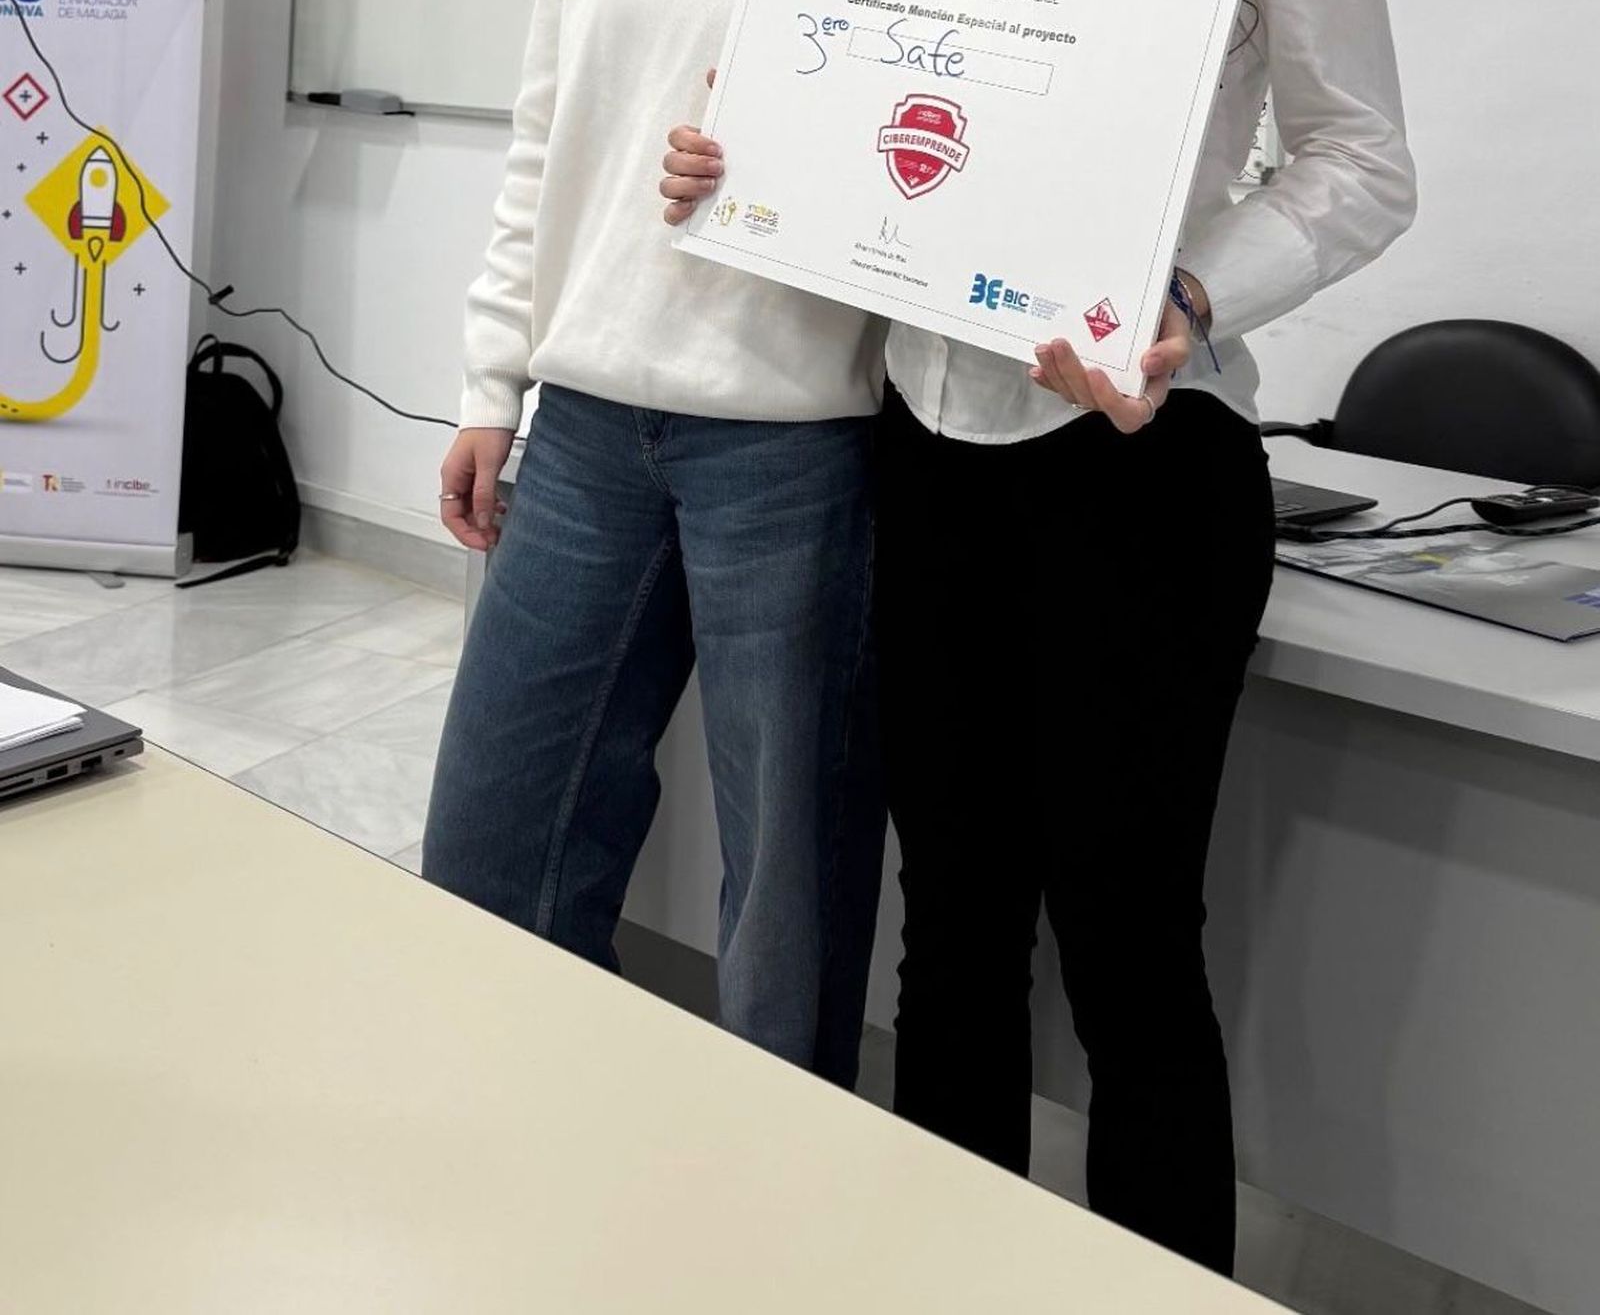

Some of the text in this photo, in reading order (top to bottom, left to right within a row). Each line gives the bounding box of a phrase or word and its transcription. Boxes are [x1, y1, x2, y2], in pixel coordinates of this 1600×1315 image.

[907, 4, 954, 22] Mención
[1009, 24, 1021, 34] al
[1022, 27, 1077, 45] proyecto
[880, 17, 966, 77] Safe
[883, 133, 962, 163] CIBEREMPRENDE
[1002, 289, 1031, 307] BIC
